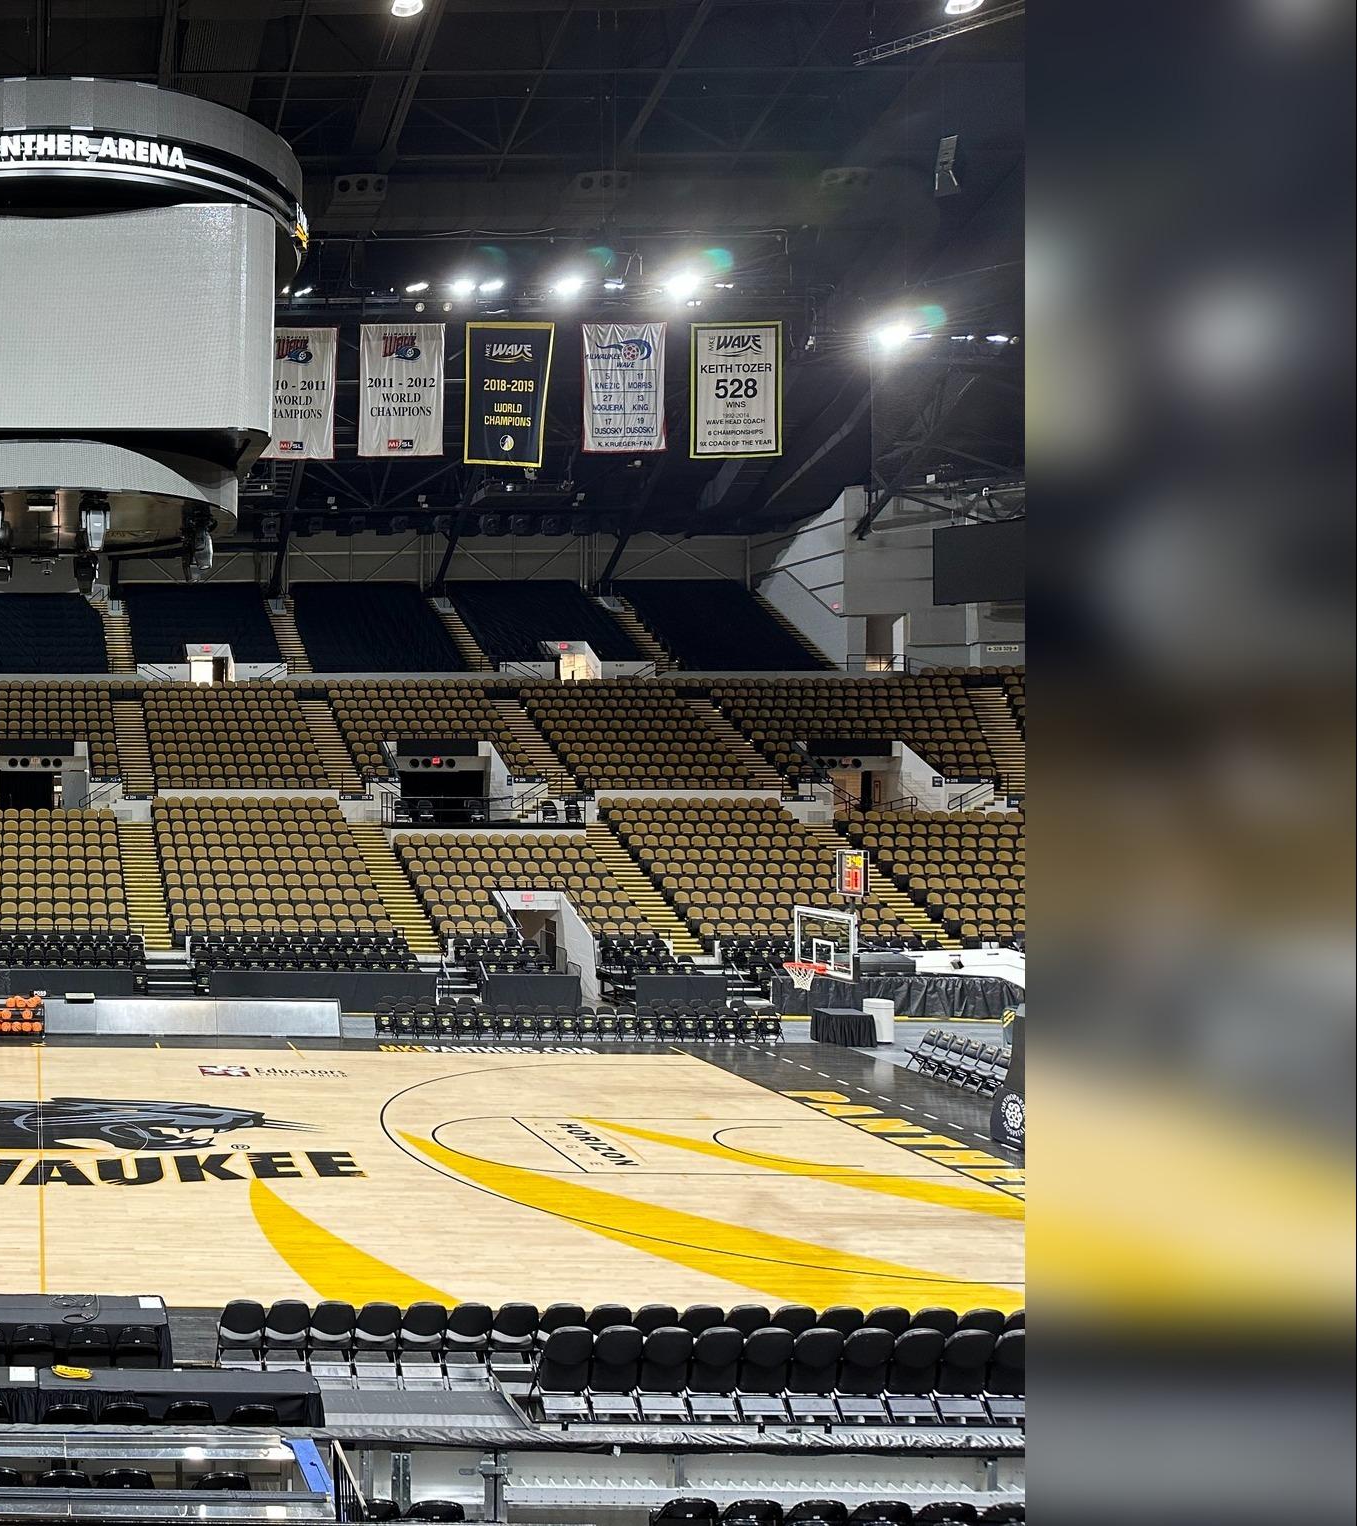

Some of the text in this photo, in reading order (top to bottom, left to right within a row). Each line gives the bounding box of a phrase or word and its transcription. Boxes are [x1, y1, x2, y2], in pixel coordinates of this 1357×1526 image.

[99, 136, 187, 169] ARENA
[716, 335, 762, 350] WAVE
[492, 344, 533, 357] WAVE
[700, 363, 772, 374] KEITH TOZER
[300, 380, 326, 390] 2011
[367, 377, 394, 388] 2011
[407, 377, 436, 388] 2012
[484, 379, 534, 392] 2018-2019
[714, 378, 758, 399] 528
[274, 395, 312, 406] WORLD
[382, 393, 421, 403] WORLD
[273, 408, 323, 419] AMPIONS
[370, 406, 432, 417] CHAMPIONS
[494, 403, 522, 413] WORLD
[484, 415, 531, 427] CHAMPIONS
[378, 1045, 600, 1054] MKEPANTHERS.COM
[254, 1067, 346, 1075] Educators
[556, 1123, 640, 1166] HORIZON
